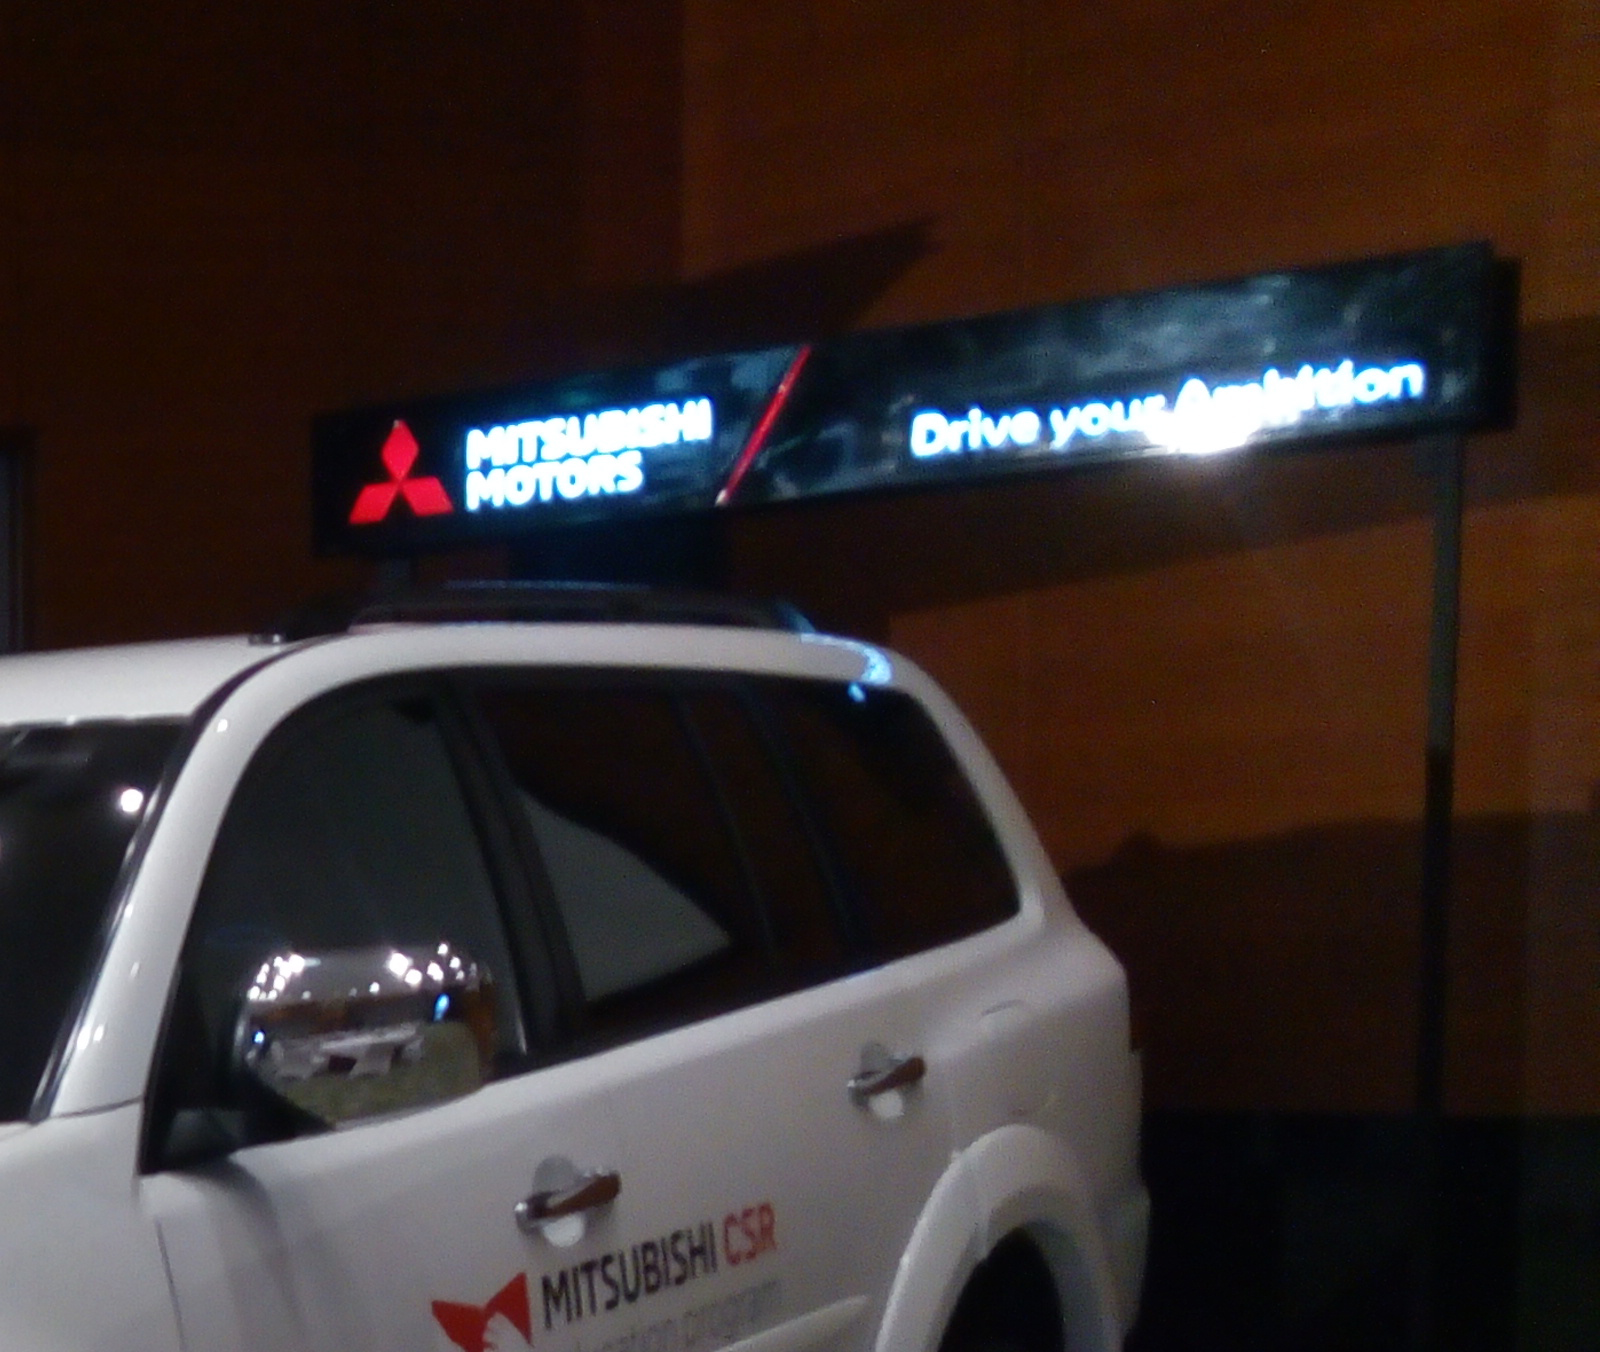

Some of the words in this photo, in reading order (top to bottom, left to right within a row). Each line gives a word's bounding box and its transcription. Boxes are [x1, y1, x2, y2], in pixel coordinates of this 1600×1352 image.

[466, 398, 713, 470] MITSUBISHI
[911, 406, 1042, 457] Drive
[466, 450, 644, 511] MOTORS
[541, 1221, 718, 1330] MITSUBISHI
[722, 1202, 777, 1266] CSR
